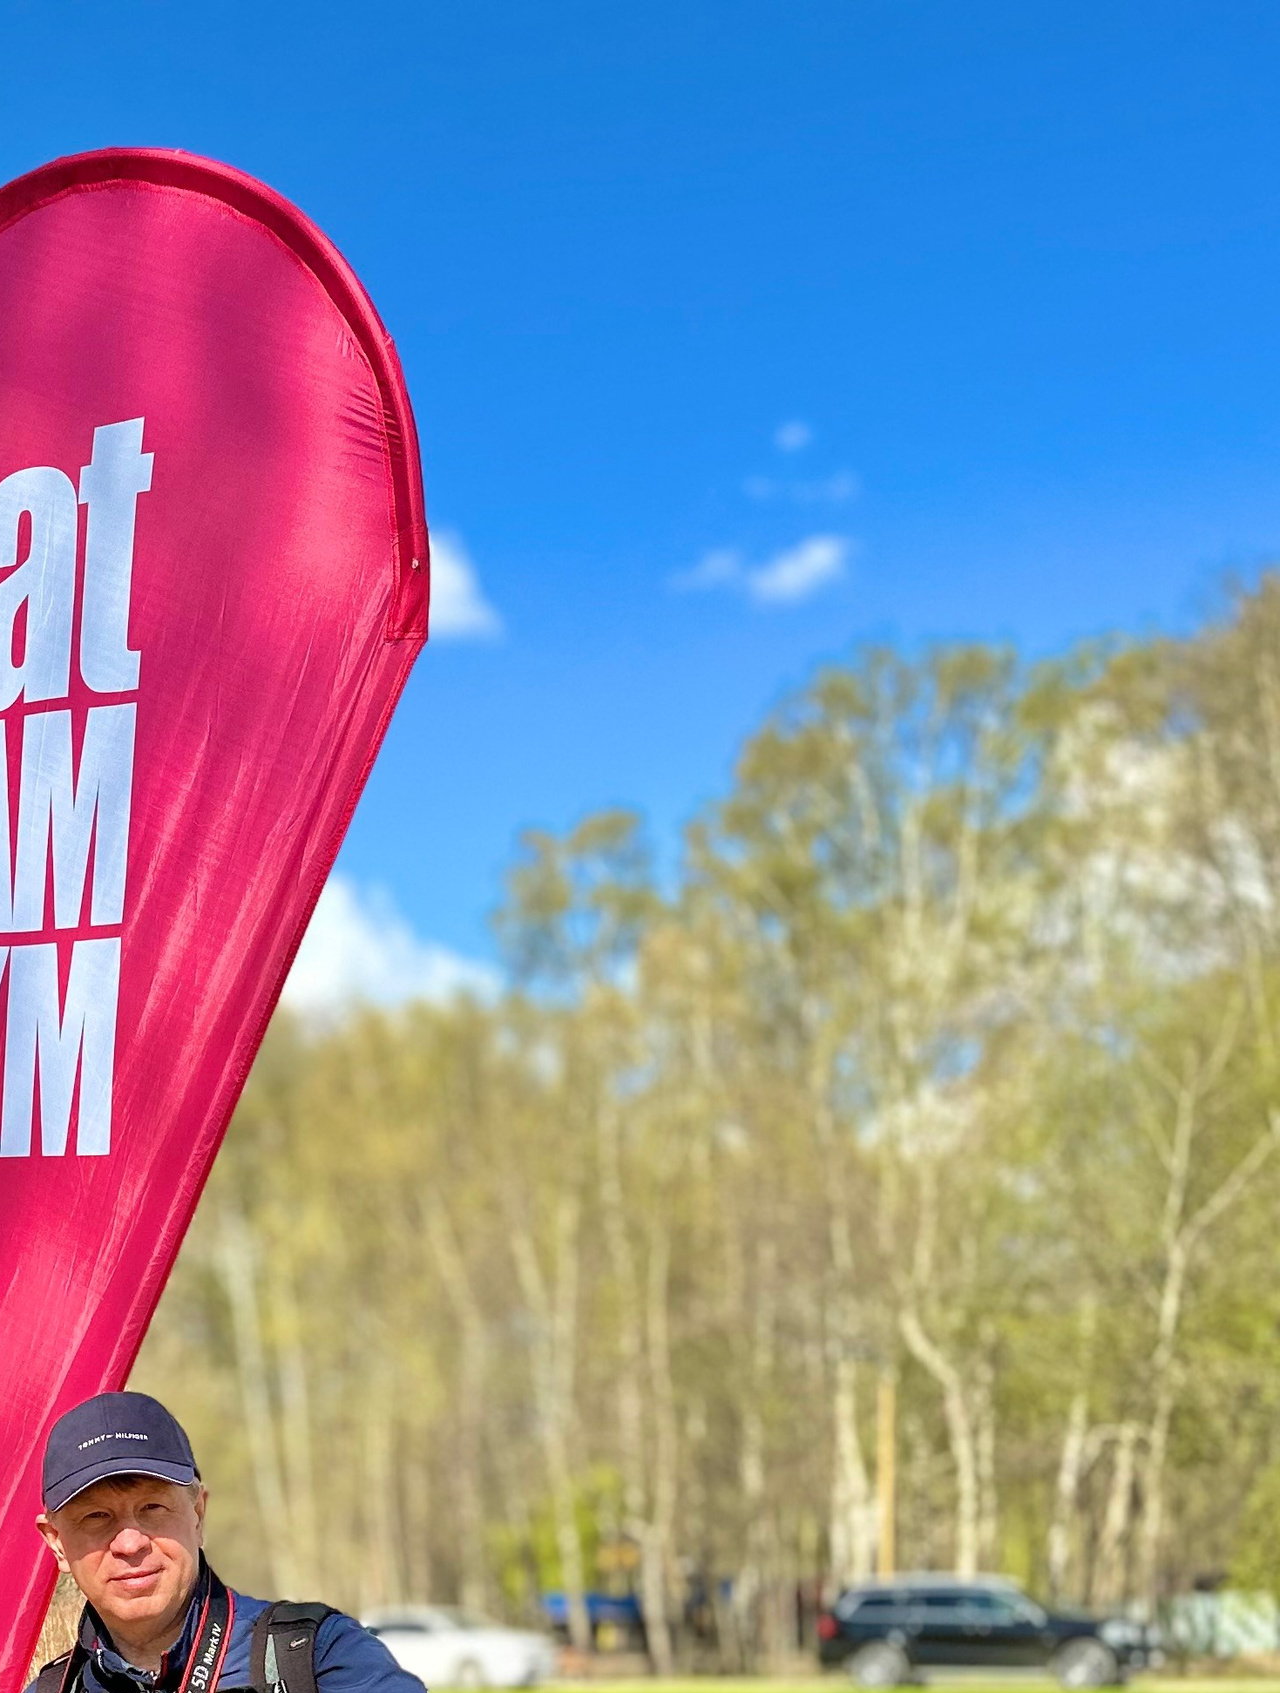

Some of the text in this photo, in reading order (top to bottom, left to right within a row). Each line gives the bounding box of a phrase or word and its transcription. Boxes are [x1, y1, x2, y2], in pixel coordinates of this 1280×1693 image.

[78, 1432, 148, 1450] TOMMY HILFIGER
[190, 1665, 209, 1690] 5D
[203, 1636, 220, 1666] Mark
[212, 1623, 222, 1637] IV
